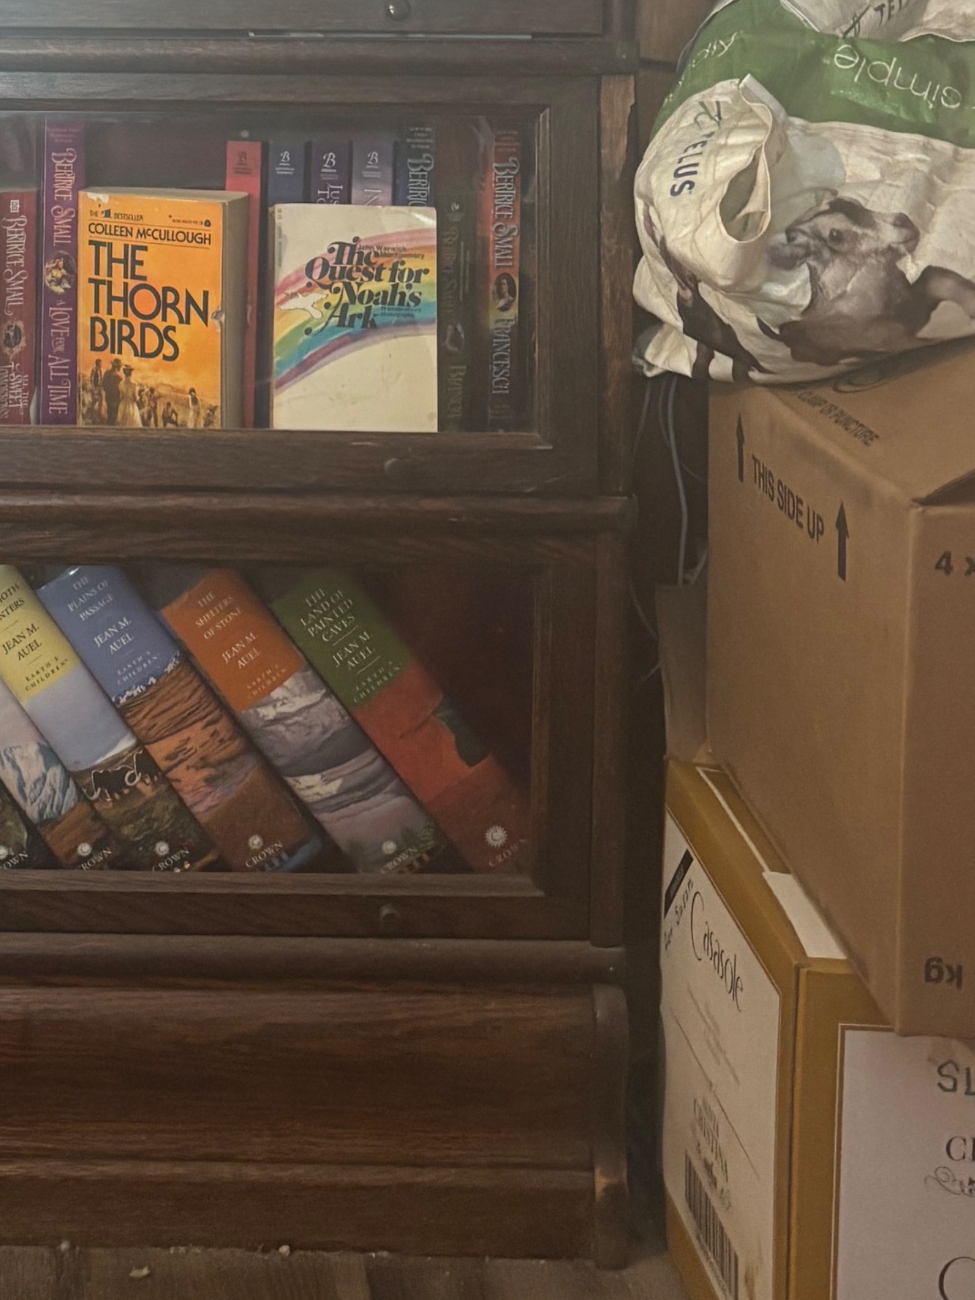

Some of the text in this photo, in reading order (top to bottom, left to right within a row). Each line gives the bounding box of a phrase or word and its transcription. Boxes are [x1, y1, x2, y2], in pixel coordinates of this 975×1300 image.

[833, 44, 962, 108] simple
[50, 149, 77, 208] BERTRICE
[51, 205, 75, 246] SMALL
[113, 212, 143, 221] BESTSELLER
[492, 157, 519, 267] BERTRICE SMALL
[88, 223, 211, 245] COLLEEN McCULLOUGH
[88, 239, 148, 281] THE
[328, 236, 380, 266] The
[305, 257, 430, 290] Quest for
[88, 277, 209, 327] THORN
[330, 281, 422, 307] Noah's
[305, 303, 377, 336] Ark
[90, 316, 180, 362] BIRDS
[47, 378, 71, 415] TIME
[828, 408, 880, 447] PUNCTURE
[751, 454, 824, 542] THIS SIDE UP
[935, 552, 953, 576] 4
[79, 593, 114, 622] PASSAGE
[194, 595, 234, 629] SHELTERS
[306, 598, 354, 638] PAINTED
[1, 623, 40, 655] JEAN M.
[93, 616, 132, 648] JEAN M.
[108, 632, 135, 655] AUEL
[202, 626, 216, 641] OF
[321, 615, 355, 643] CAVES
[16, 640, 43, 661] AUEL
[221, 641, 247, 664] JEAN
[236, 648, 261, 670] AUEL
[332, 641, 360, 668] JEAN
[345, 647, 376, 671] AUEL
[923, 956, 962, 988] kg
